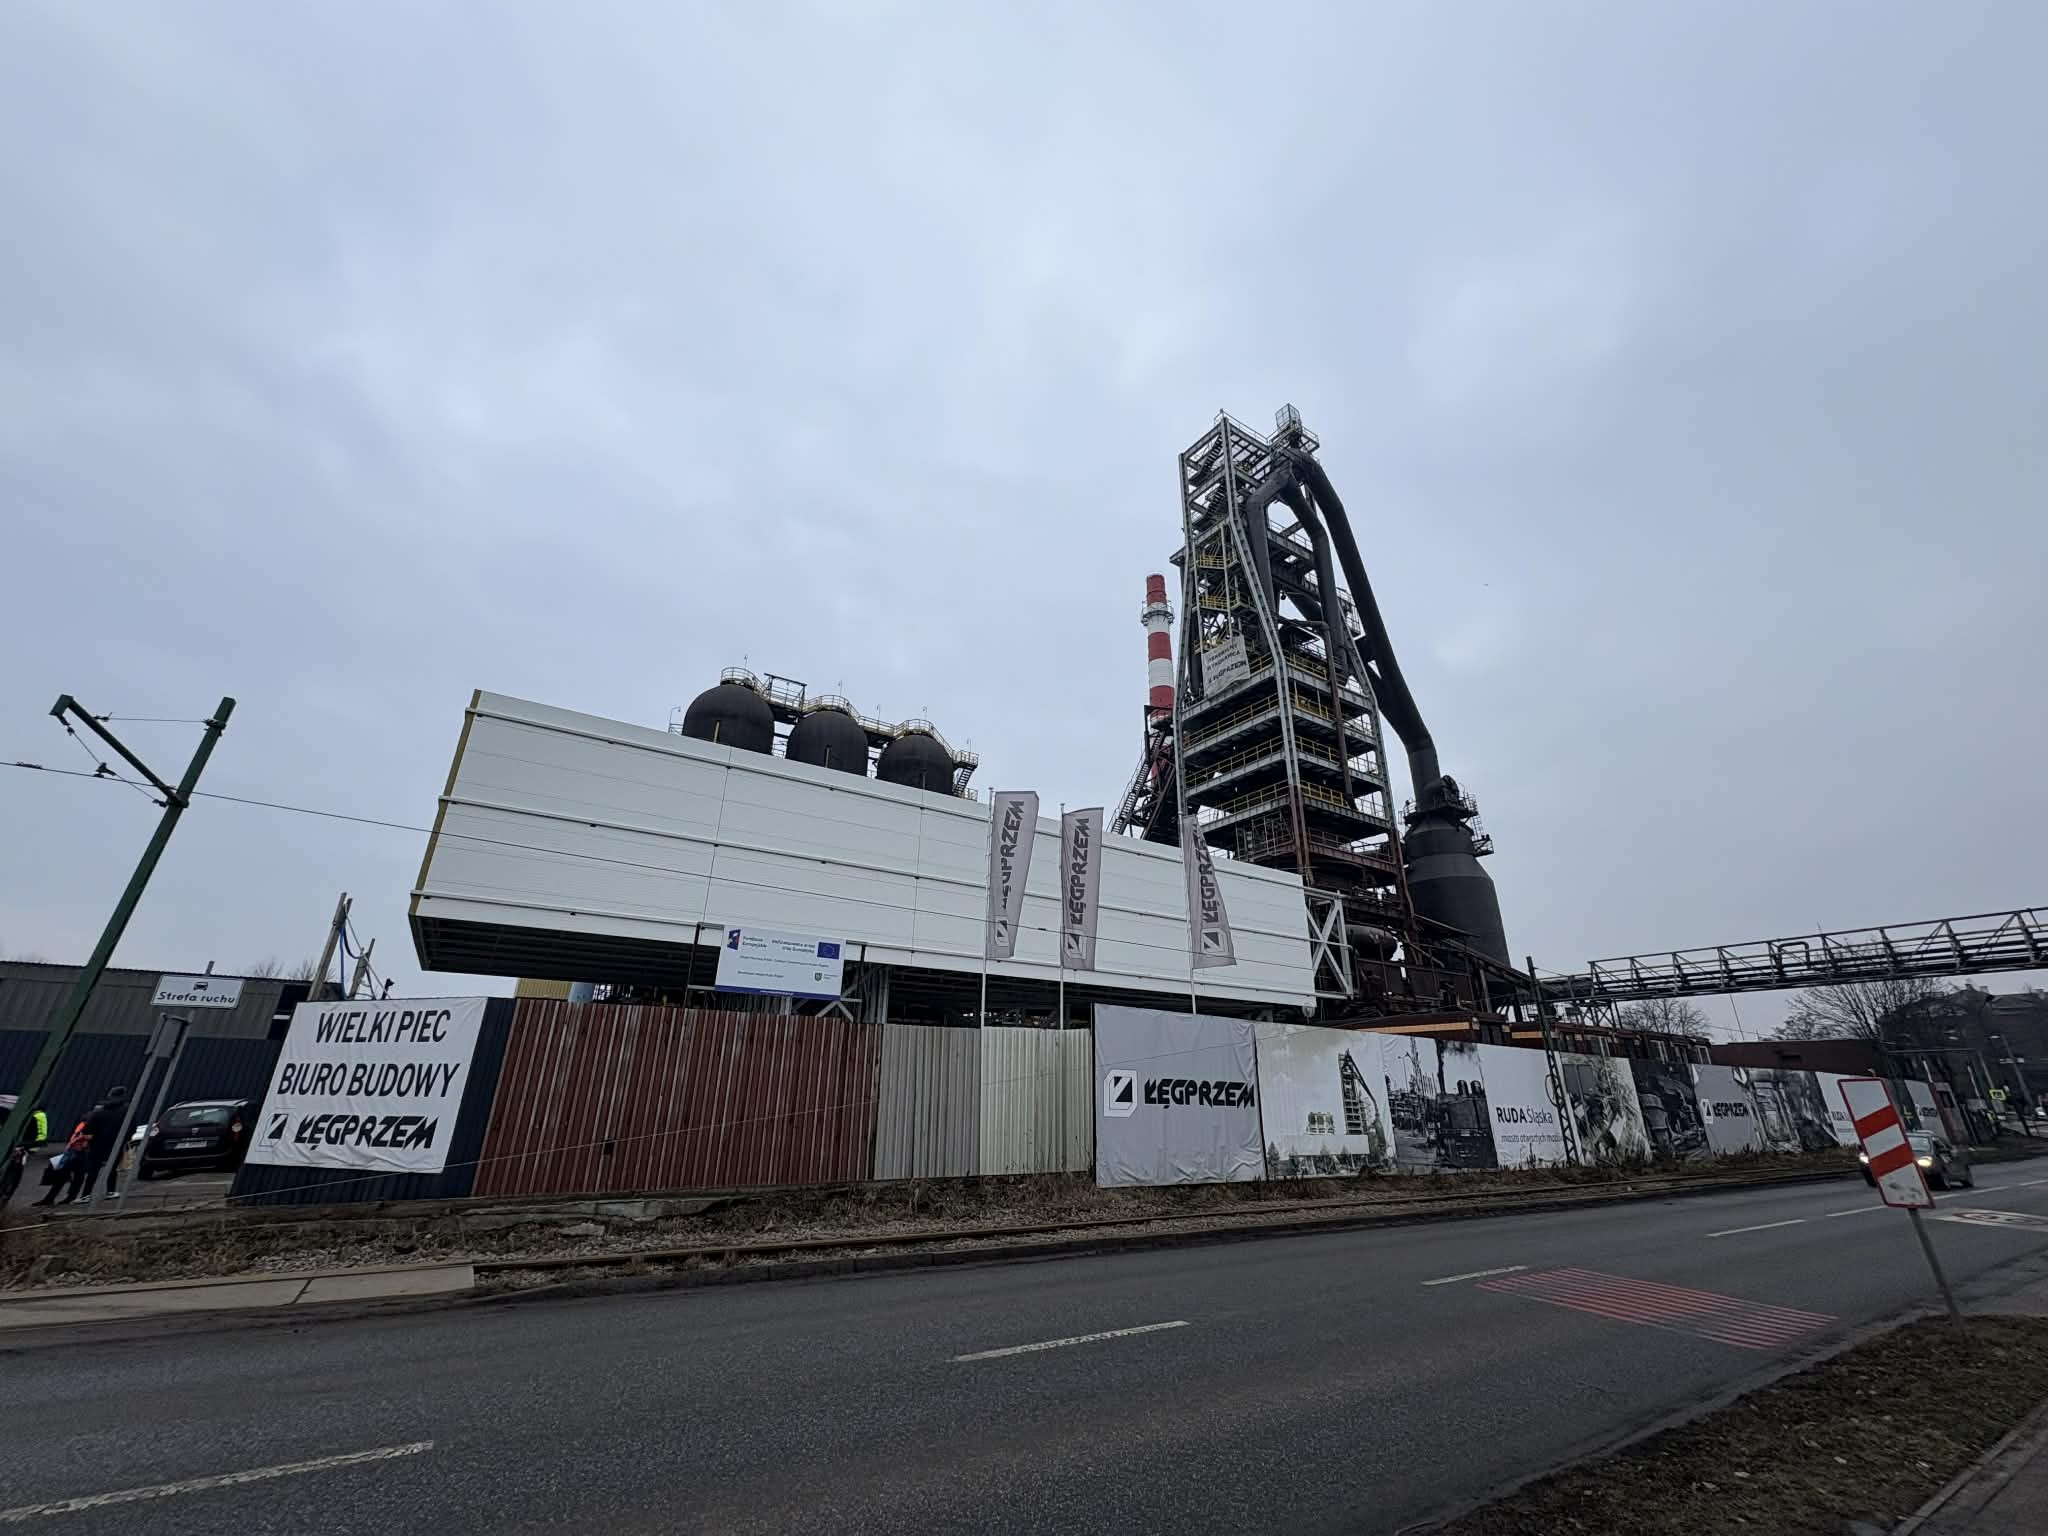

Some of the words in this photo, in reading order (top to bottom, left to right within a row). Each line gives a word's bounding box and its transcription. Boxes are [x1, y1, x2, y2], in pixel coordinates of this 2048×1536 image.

[1000, 800, 1024, 910] GPRZEM
[157, 991, 198, 1002] Strefa
[200, 994, 235, 1003] ruchu
[316, 1011, 397, 1043] WIELKI
[395, 1009, 451, 1043] PIEC
[277, 1062, 348, 1096] BIURO
[346, 1063, 461, 1098] BUDOWY
[1144, 1078, 1256, 1110] ŁĘGPRZEM
[294, 1113, 440, 1151] ŁĘGPRZEM
[1496, 1106, 1527, 1124] RUDA
[1526, 1104, 1554, 1127] Śląska
